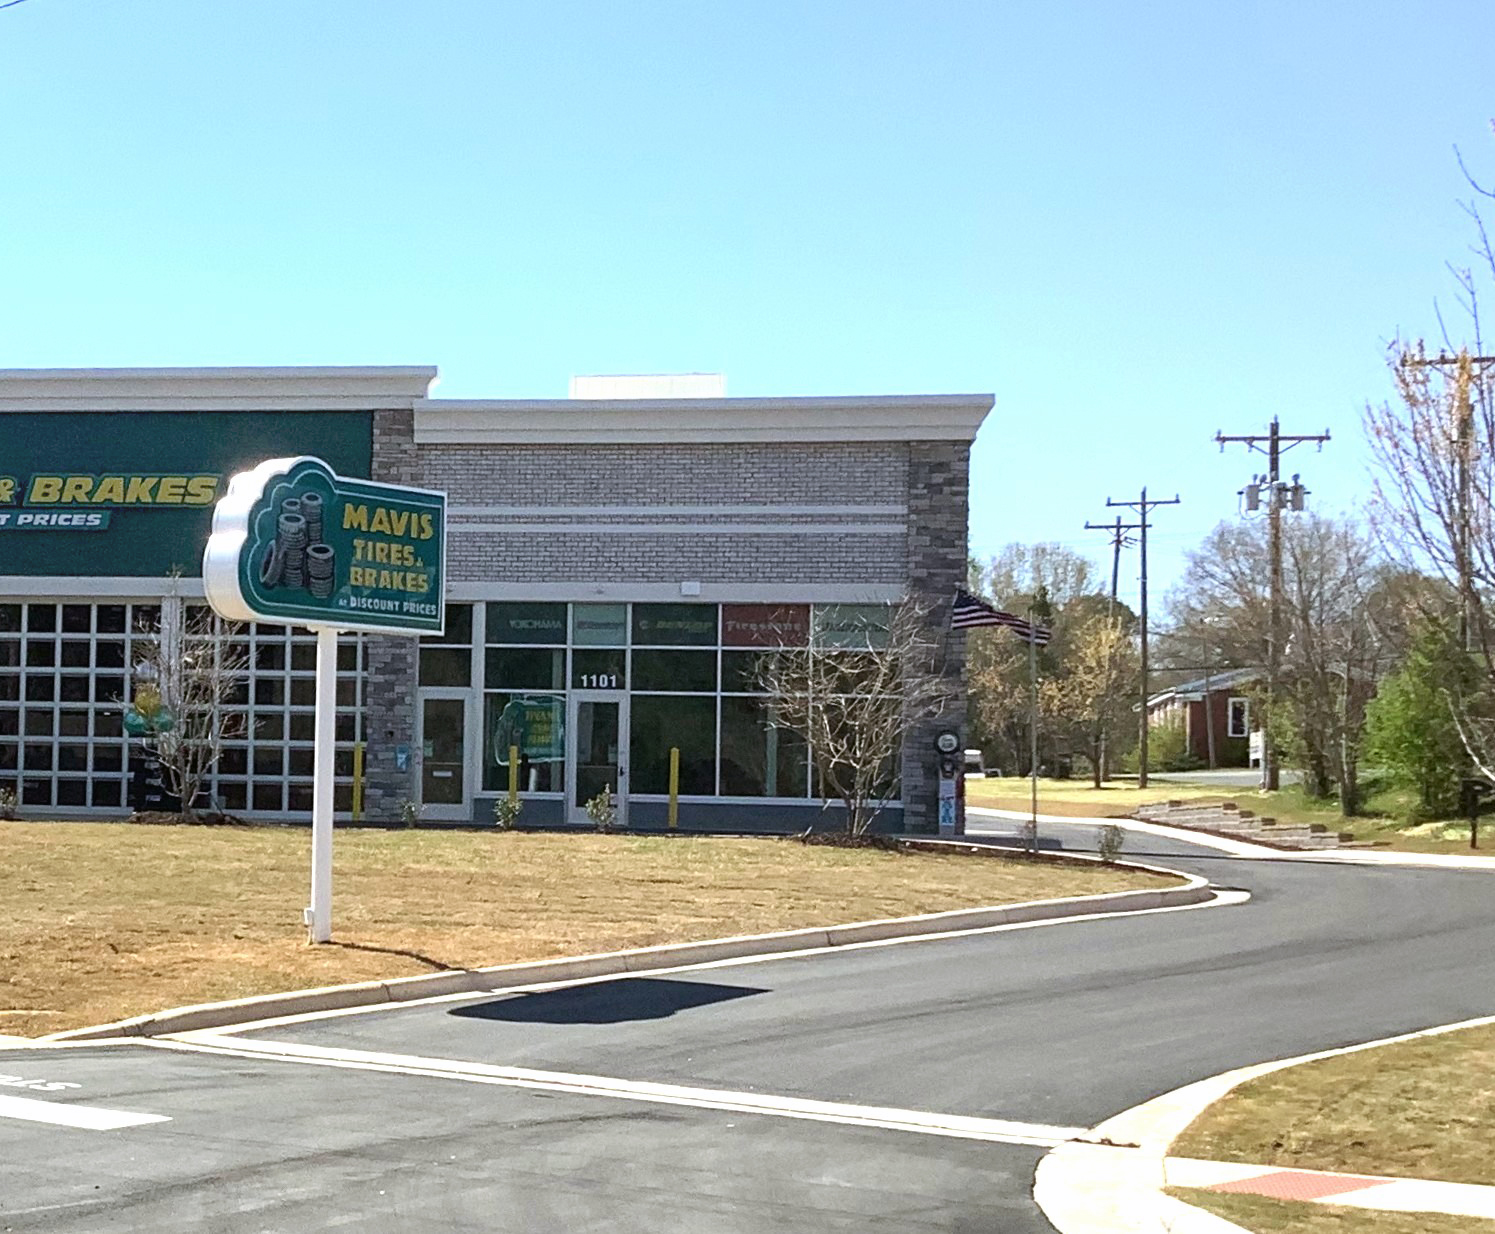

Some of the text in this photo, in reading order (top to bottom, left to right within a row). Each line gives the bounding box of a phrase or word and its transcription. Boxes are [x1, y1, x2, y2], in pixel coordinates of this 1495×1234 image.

[30, 477, 218, 503] BRAKES
[17, 513, 102, 526] PRICES
[343, 503, 433, 539] MAVIS
[353, 538, 414, 567] TIRES
[350, 566, 429, 592] BRAKES
[350, 595, 400, 611] DISCOUNT
[403, 601, 436, 615] PRICES
[581, 675, 616, 688] 1101
